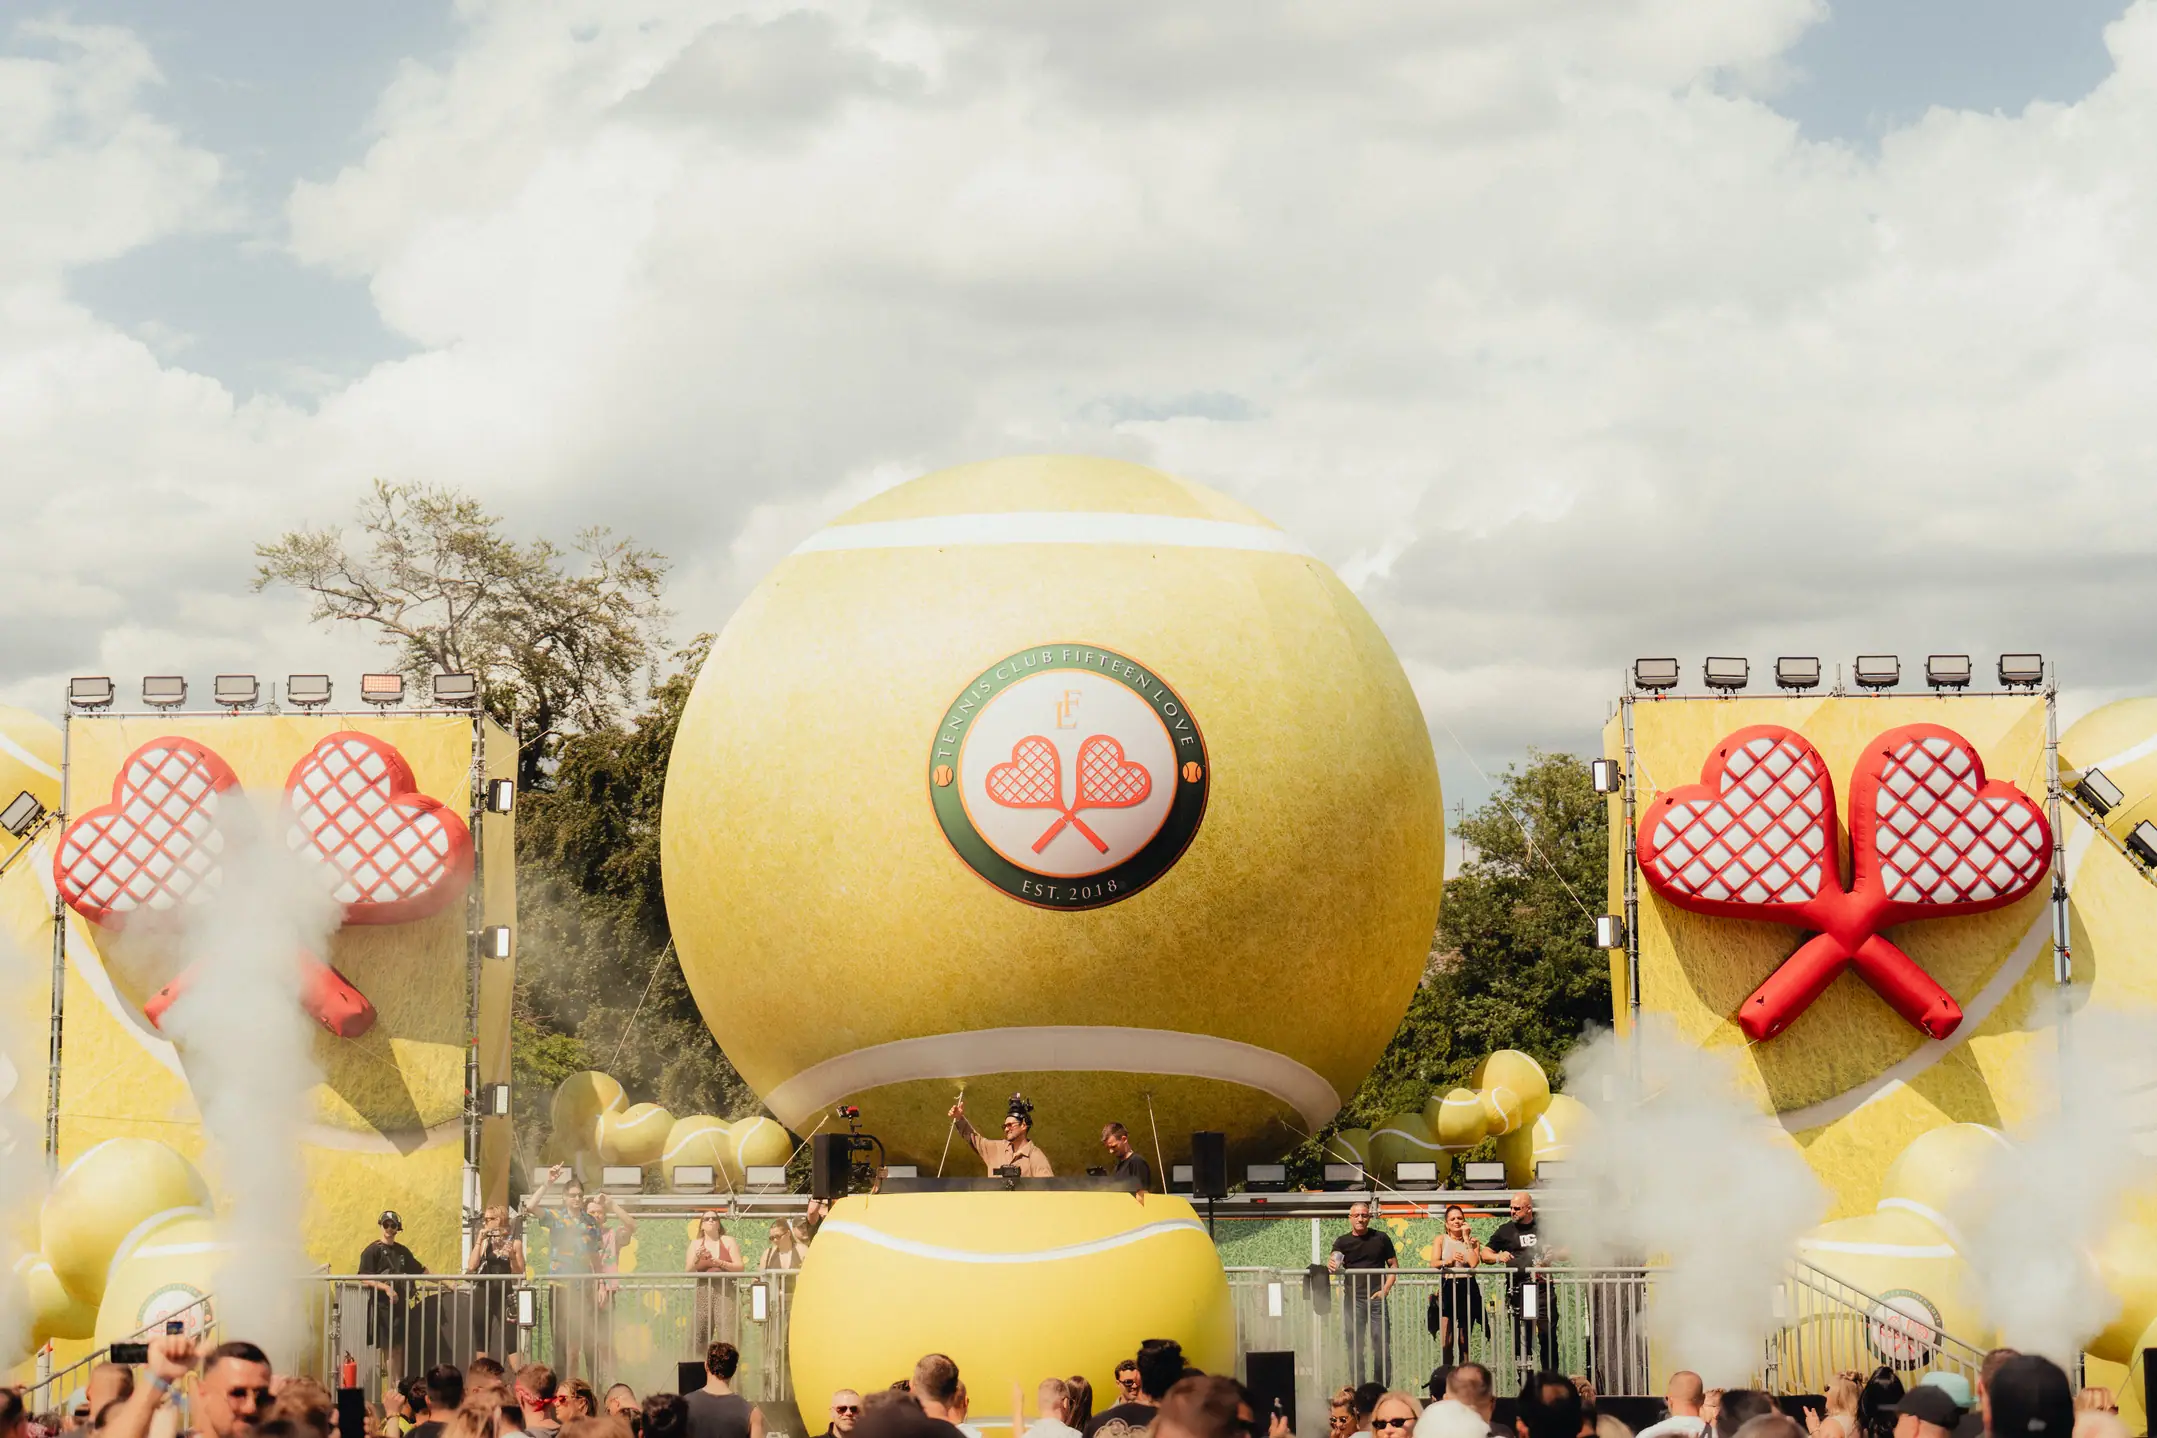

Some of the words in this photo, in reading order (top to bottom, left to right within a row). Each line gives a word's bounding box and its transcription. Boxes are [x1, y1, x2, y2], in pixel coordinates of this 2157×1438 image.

[937, 680, 991, 758] TENNIS
[996, 651, 1053, 680] CLUB
[1063, 649, 1151, 689] FIFTEEN
[1153, 689, 1194, 746] LOVE
[1022, 880, 1060, 900] EST.
[1069, 880, 1117, 900] 2018
